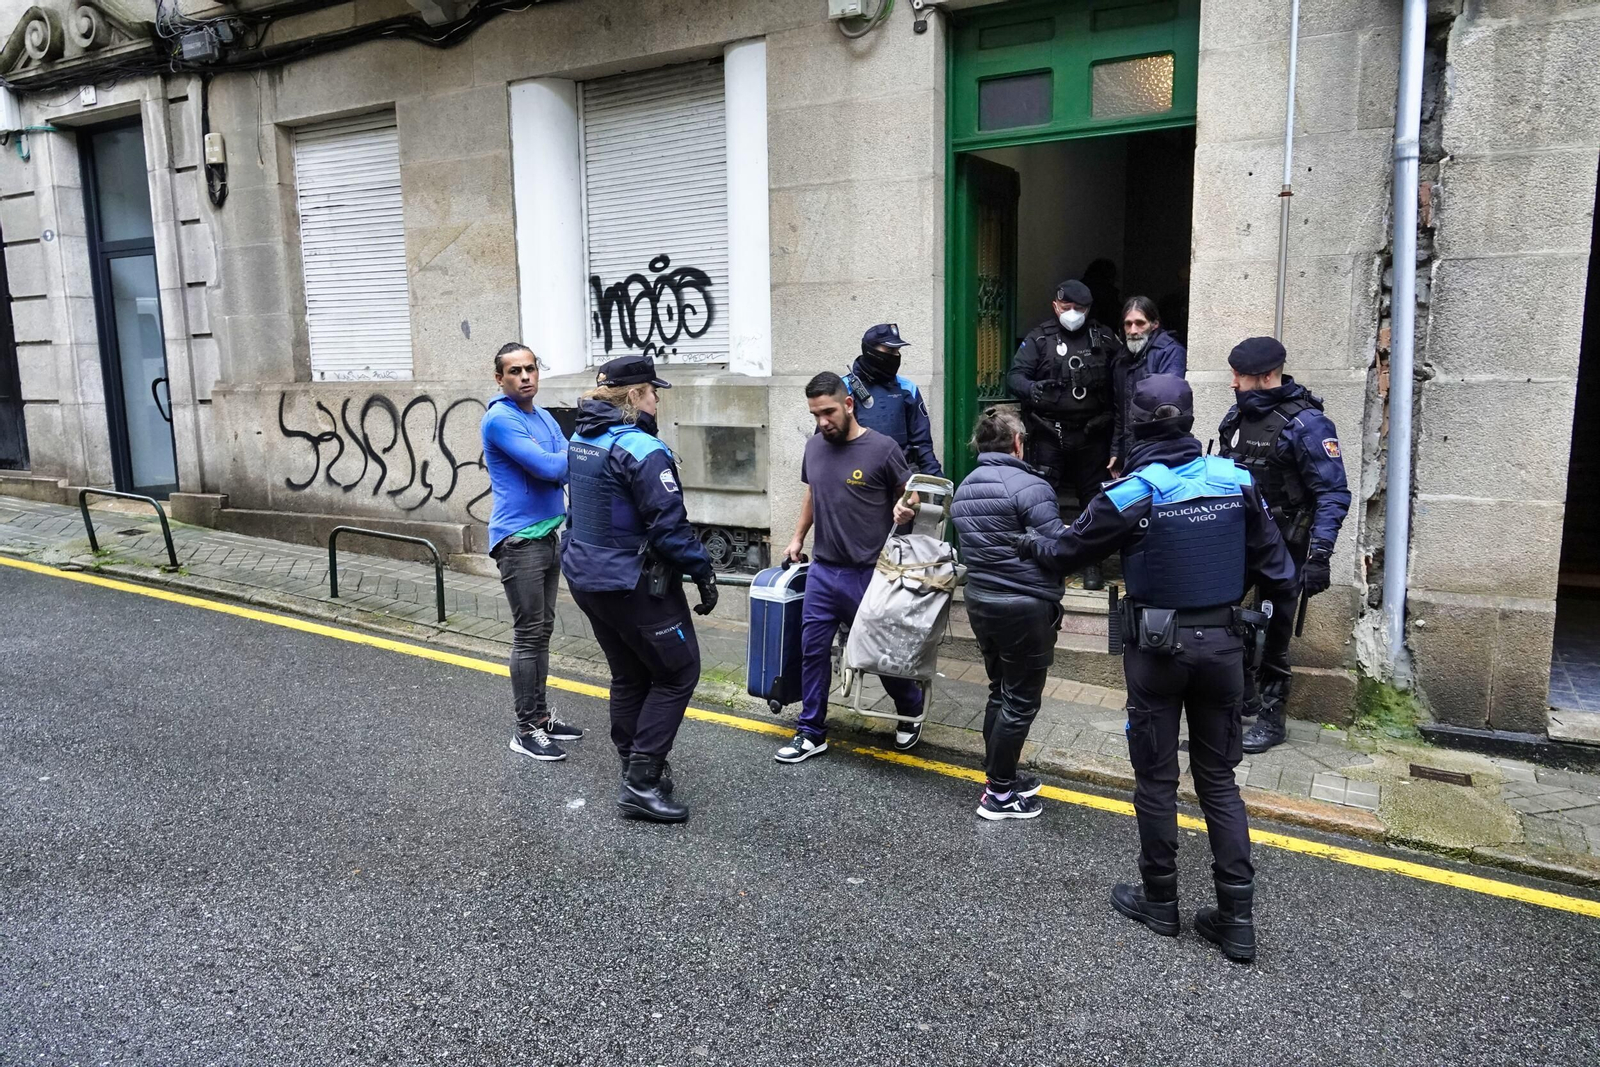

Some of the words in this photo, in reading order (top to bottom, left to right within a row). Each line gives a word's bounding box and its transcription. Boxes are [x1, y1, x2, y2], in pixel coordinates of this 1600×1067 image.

[586, 449, 600, 457] LOCAL
[576, 454, 588, 462] VIGO
[1158, 506, 1202, 518] POLICÍA
[1209, 501, 1243, 511] LOCAL
[1188, 513, 1217, 523] VIGO
